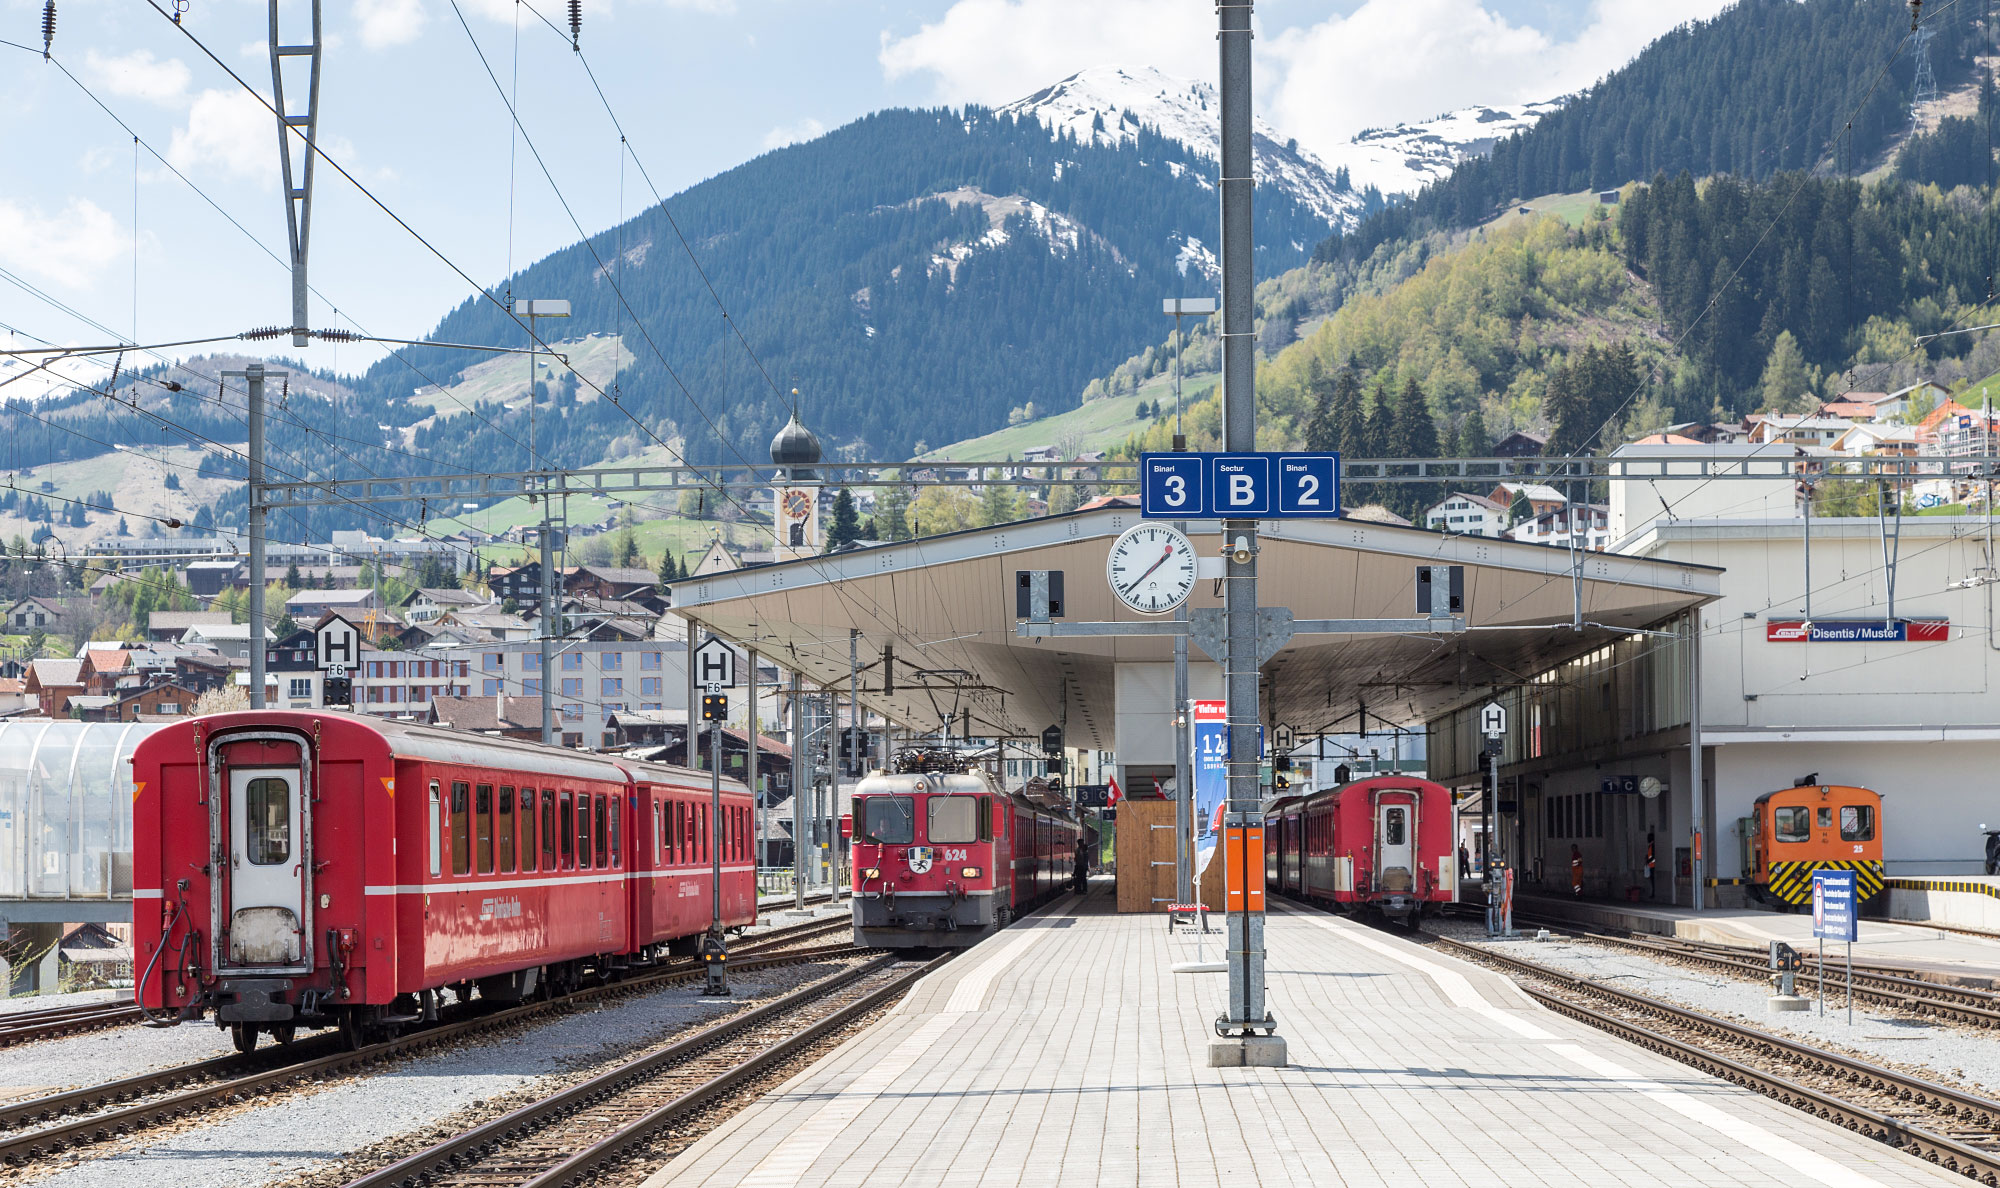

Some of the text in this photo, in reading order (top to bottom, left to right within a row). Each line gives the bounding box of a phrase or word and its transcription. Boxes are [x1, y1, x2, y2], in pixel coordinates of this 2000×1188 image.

[1154, 465, 1175, 473] Binari
[1164, 475, 1187, 507] 3
[1229, 475, 1255, 506] B
[1297, 474, 1320, 506] 2
[325, 631, 350, 662] H
[329, 664, 344, 676] F6
[702, 652, 726, 680] H
[707, 682, 721, 693] F6
[1486, 710, 1501, 729] H
[1277, 731, 1290, 746] H
[1607, 781, 1633, 791] 1 C
[1081, 790, 1107, 801] 3 C
[444, 795, 449, 827] 2
[944, 849, 967, 861] 624
[1853, 845, 1863, 853] 25
